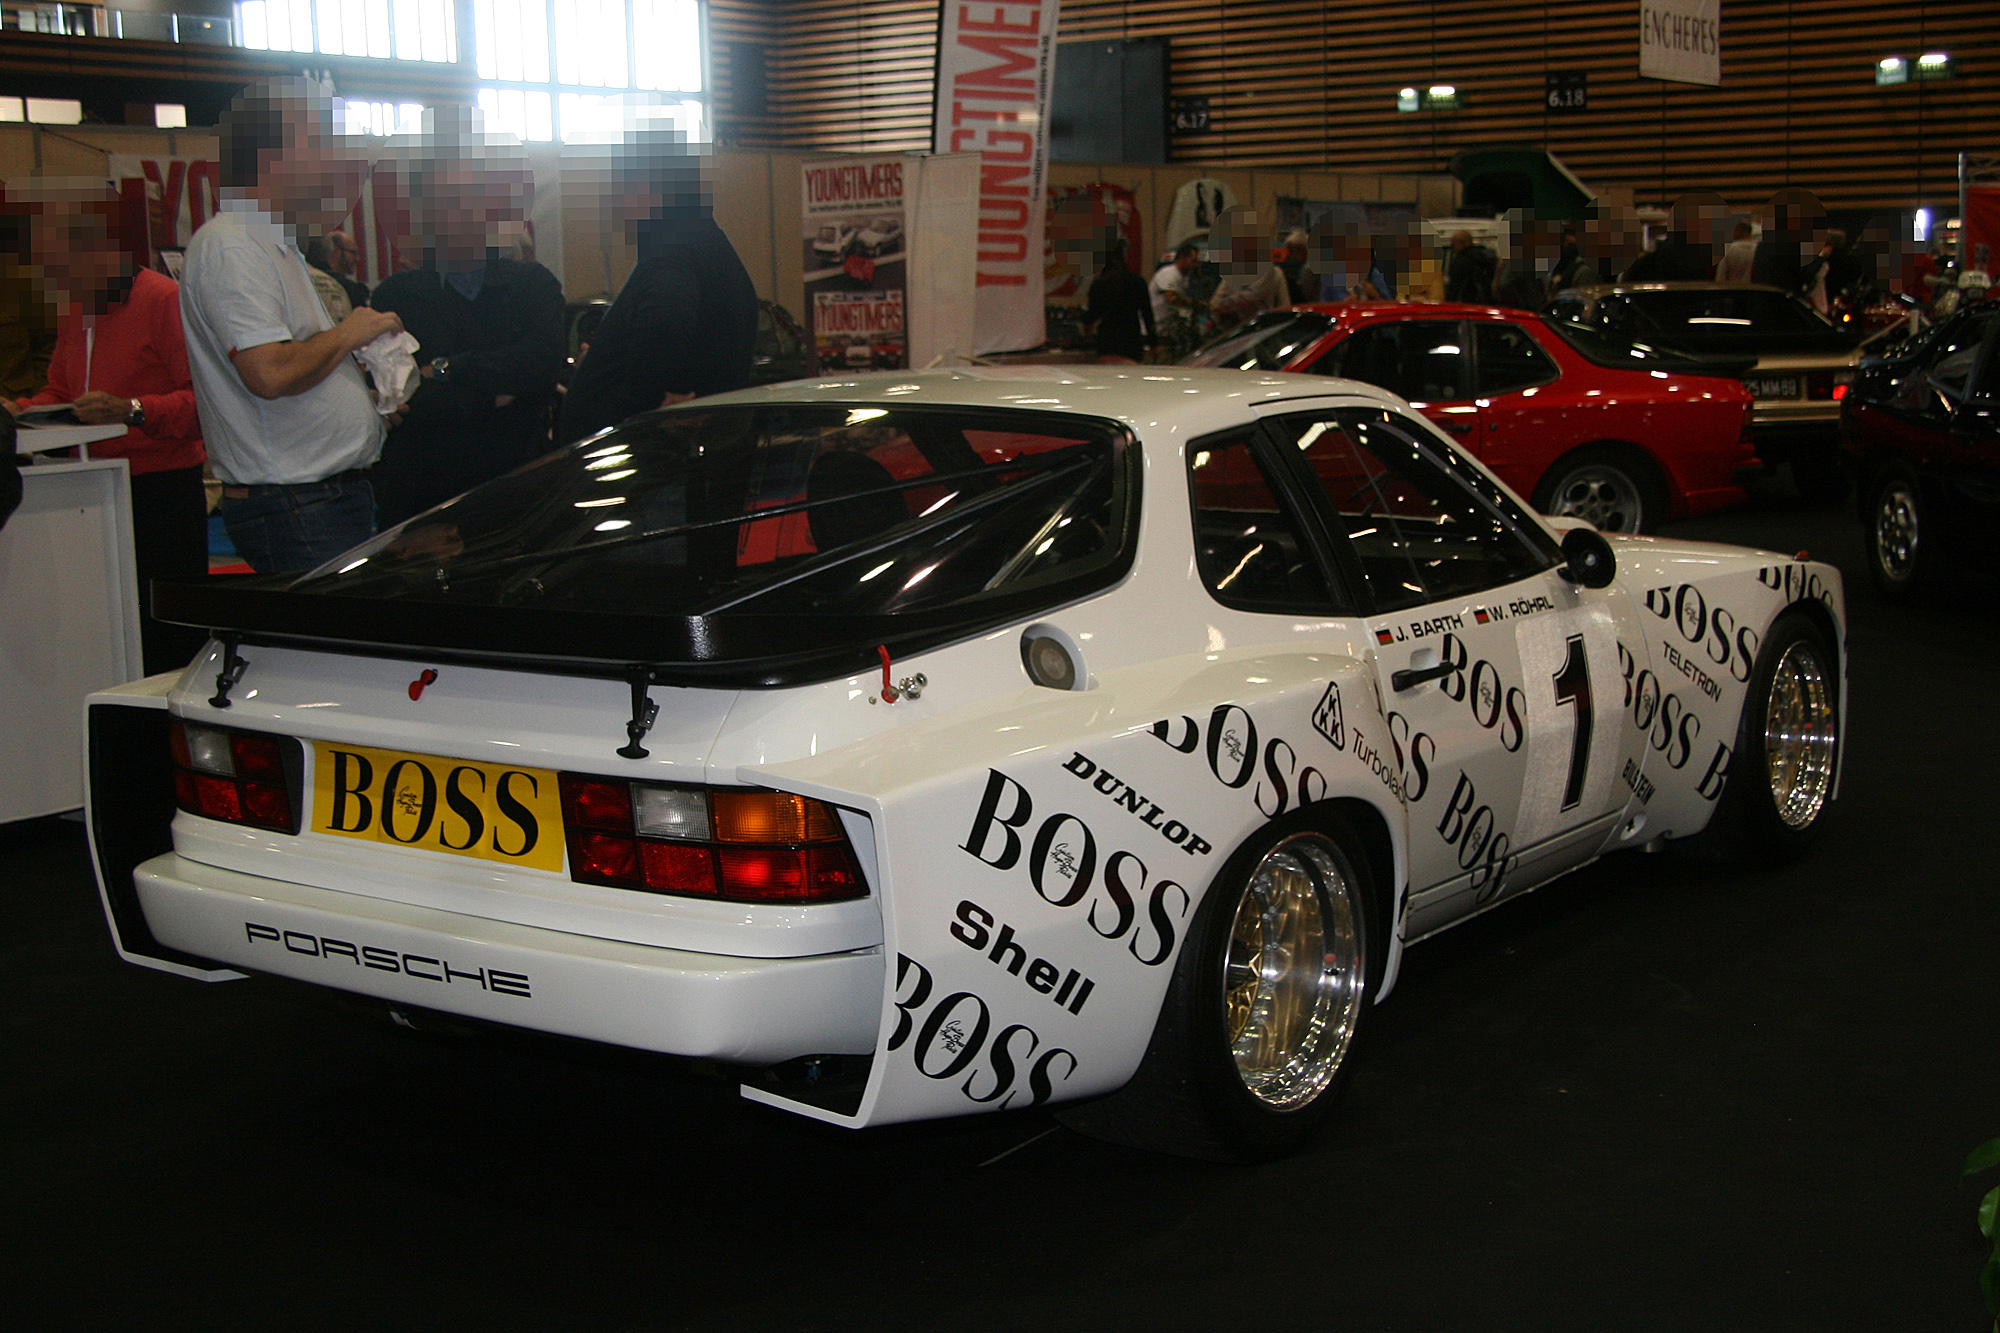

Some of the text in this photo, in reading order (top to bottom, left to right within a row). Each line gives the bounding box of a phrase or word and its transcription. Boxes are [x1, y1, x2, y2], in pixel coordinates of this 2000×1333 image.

[1643, 7, 1716, 55] ENCHERES
[1176, 111, 1207, 129] 6.17
[1549, 88, 1585, 107] 6.18
[805, 162, 903, 203] YOUNGTIMERS
[1396, 614, 1464, 642] J. BARTH
[1489, 596, 1555, 622] W. RÖHRL
[1663, 641, 1722, 702] TELETRON
[1552, 633, 1594, 813] 1
[326, 749, 539, 857] BOSS
[1062, 751, 1213, 856] DUNLOP
[958, 767, 1191, 966] BOSS
[245, 922, 532, 998] PORSCHE
[950, 900, 1096, 1016] Shell
